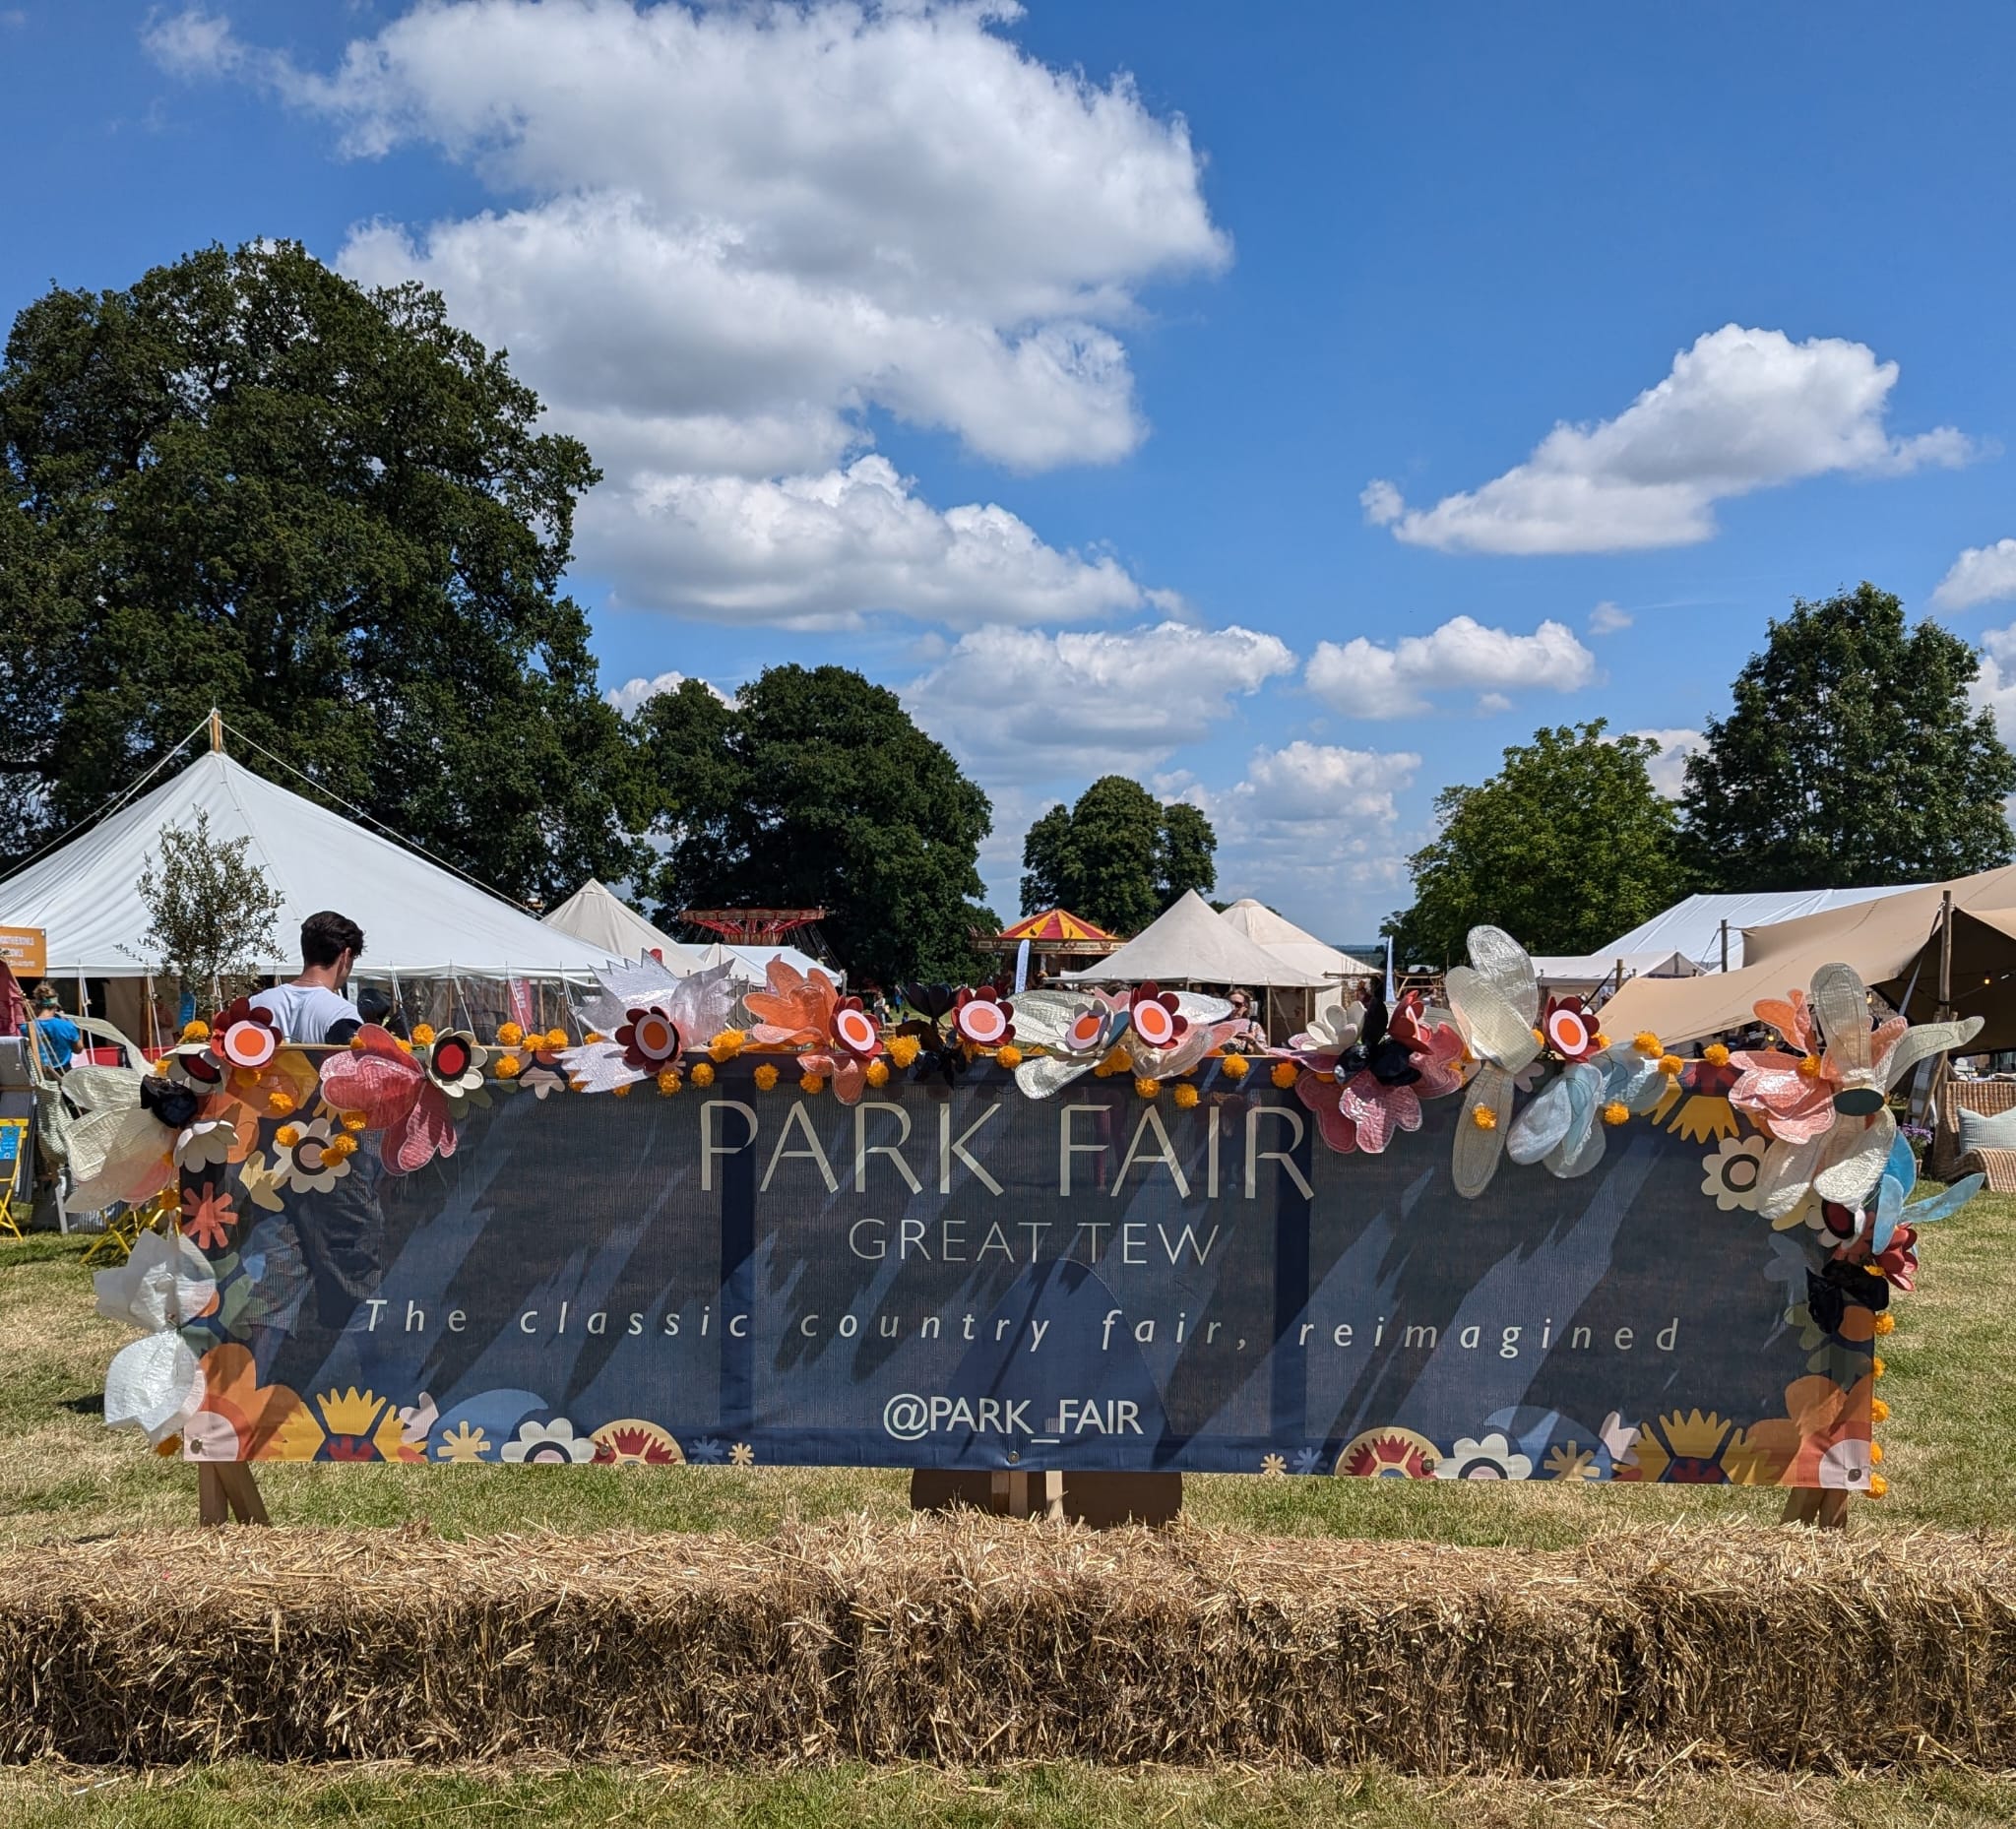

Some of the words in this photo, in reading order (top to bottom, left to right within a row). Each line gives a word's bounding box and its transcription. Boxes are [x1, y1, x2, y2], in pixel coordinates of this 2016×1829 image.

[700, 1100, 1005, 1196] PARK
[1059, 1104, 1315, 1200] FAIR
[849, 1219, 1052, 1263] GREAT
[1078, 1223, 1220, 1266] TEW
[365, 1298, 468, 1333] The
[520, 1300, 748, 1337] classic
[799, 1313, 1049, 1353] country
[1102, 1309, 1247, 1351] fair,
[1298, 1316, 1680, 1358] reimagined
[883, 1393, 1144, 1444] @PARK_FAIR
